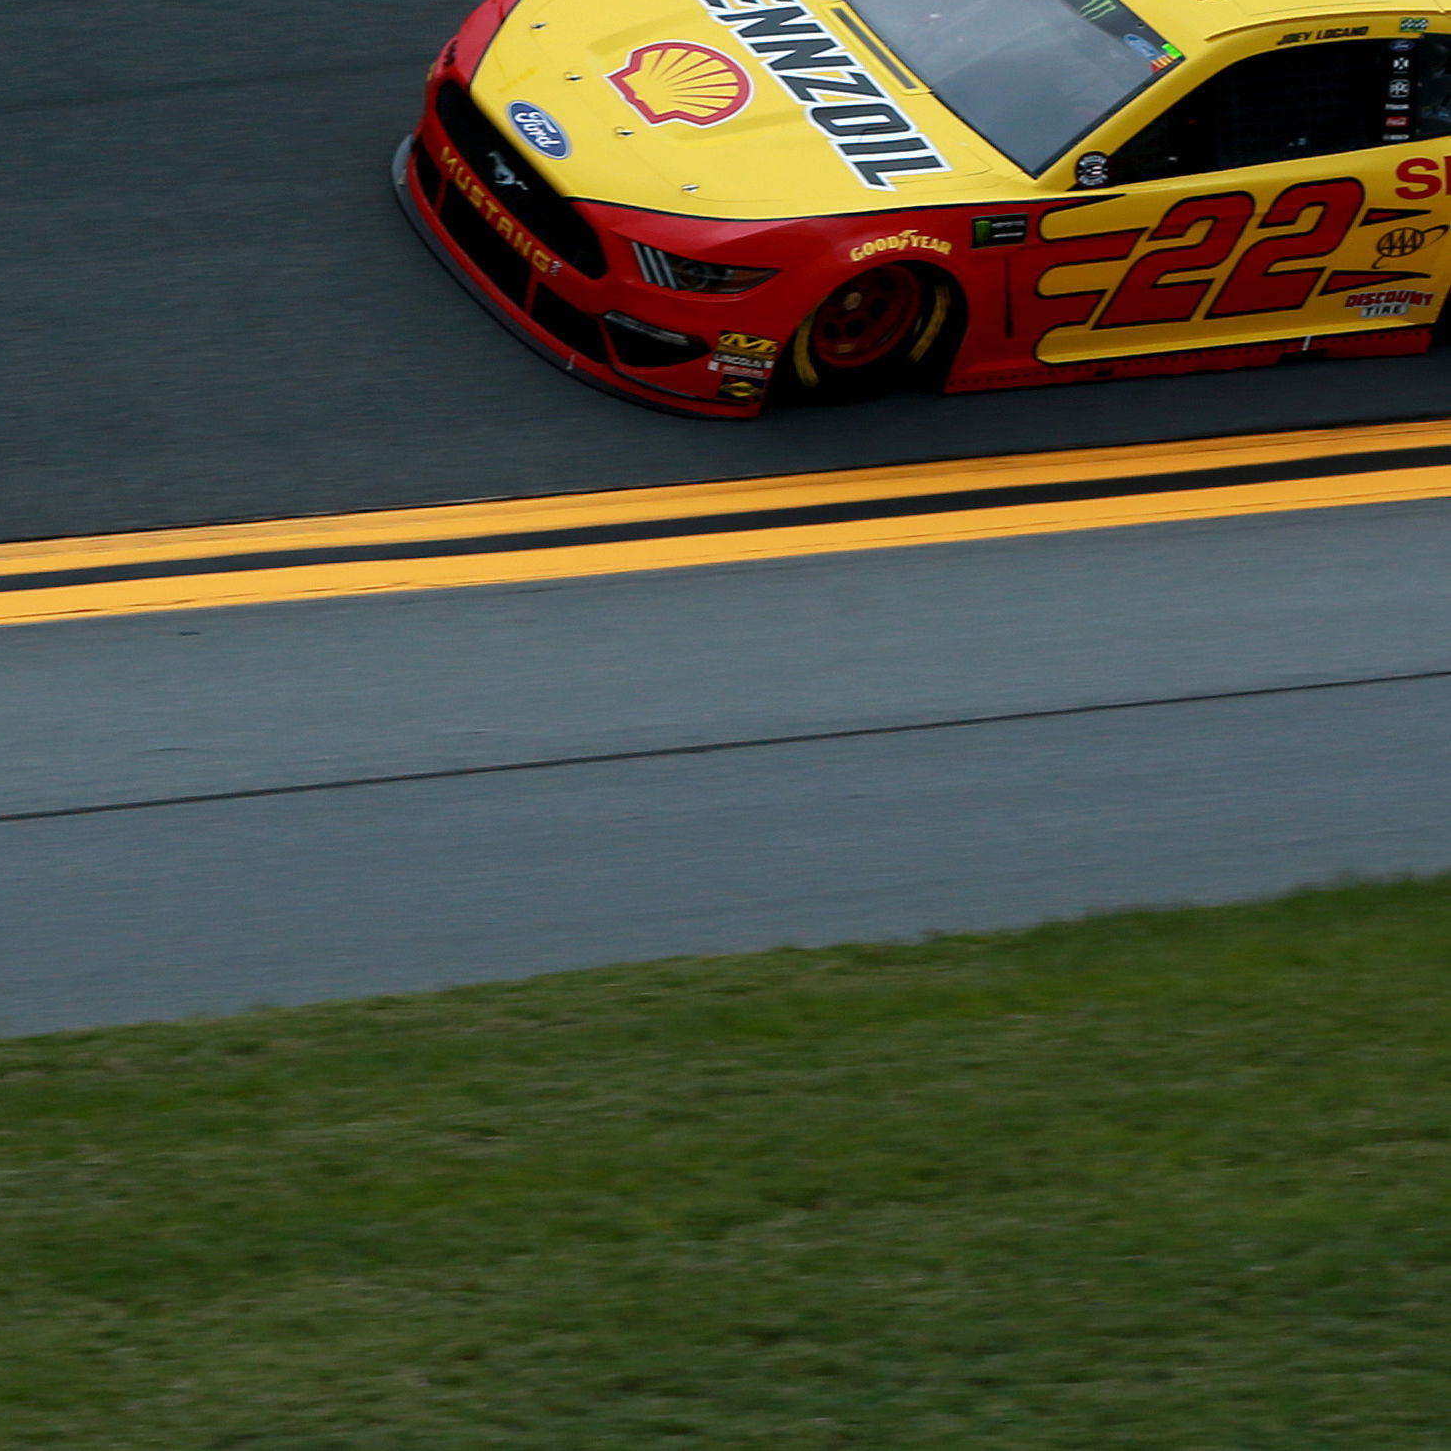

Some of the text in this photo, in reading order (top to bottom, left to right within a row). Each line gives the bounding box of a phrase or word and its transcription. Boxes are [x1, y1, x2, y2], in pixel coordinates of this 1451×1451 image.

[515, 111, 561, 148] Ford
[1395, 156, 1451, 200] S
[440, 146, 551, 273] MUSTANG
[850, 230, 952, 262] GOODYEAR
[1097, 178, 1367, 331] 22
[1345, 290, 1434, 309] DISCOUNT
[1365, 303, 1403, 316] TIRE
